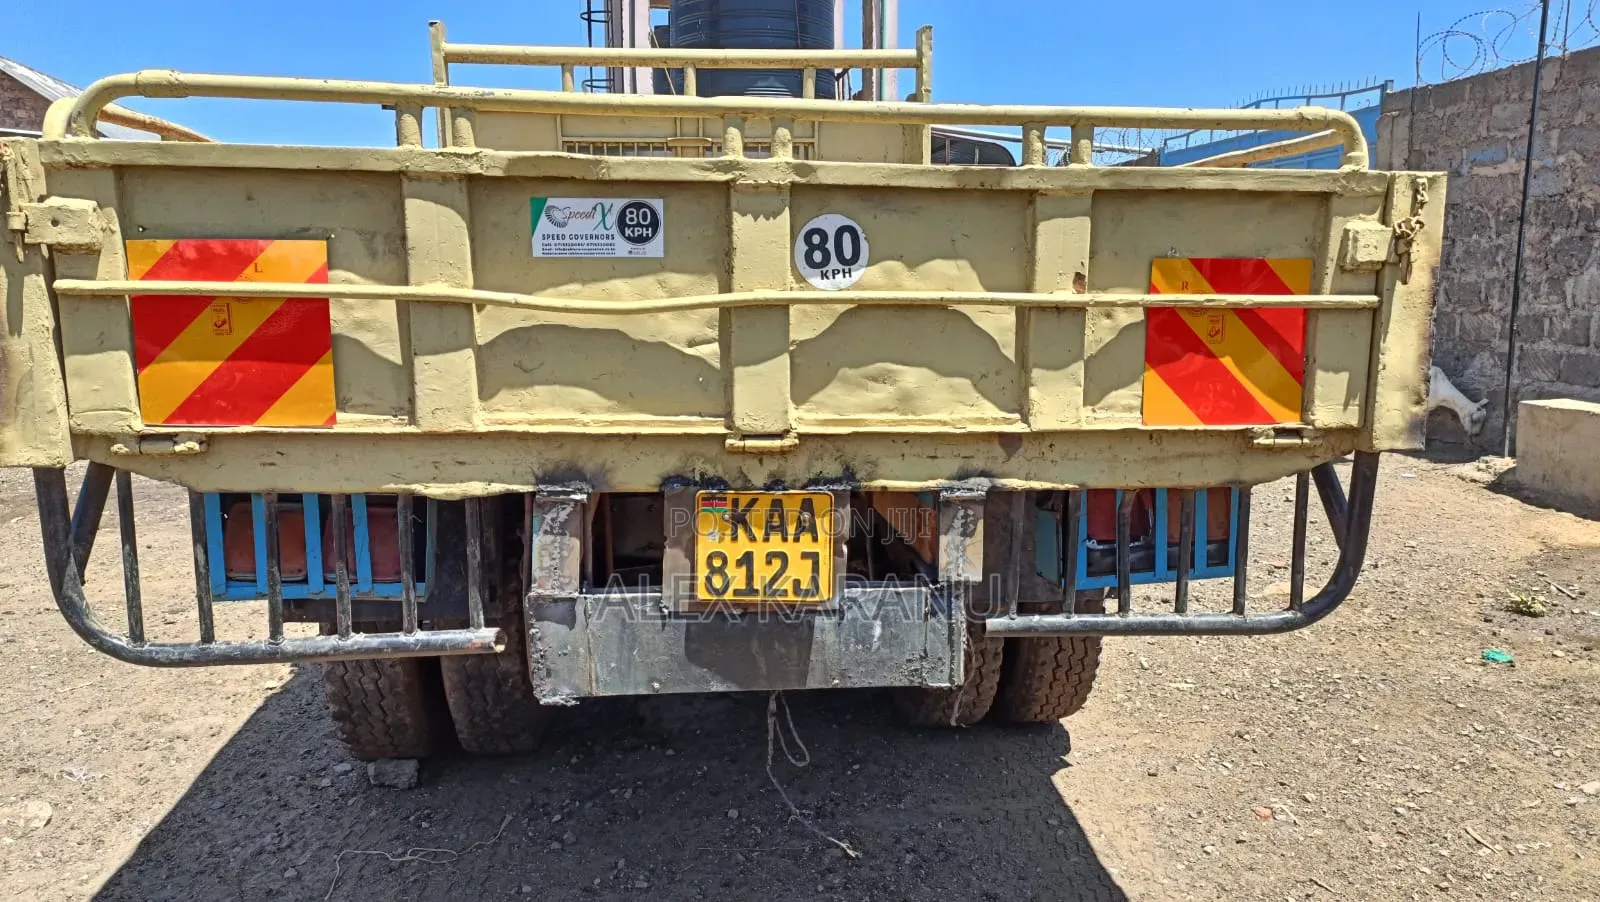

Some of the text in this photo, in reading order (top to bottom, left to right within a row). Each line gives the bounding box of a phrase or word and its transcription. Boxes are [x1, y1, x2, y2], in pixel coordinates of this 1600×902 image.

[625, 208, 651, 225] 80
[624, 227, 652, 237] KPH
[803, 224, 861, 269] 80
[254, 263, 263, 273] L
[820, 267, 852, 280] KPH
[730, 497, 819, 543] KAA
[705, 551, 820, 597] 812J
